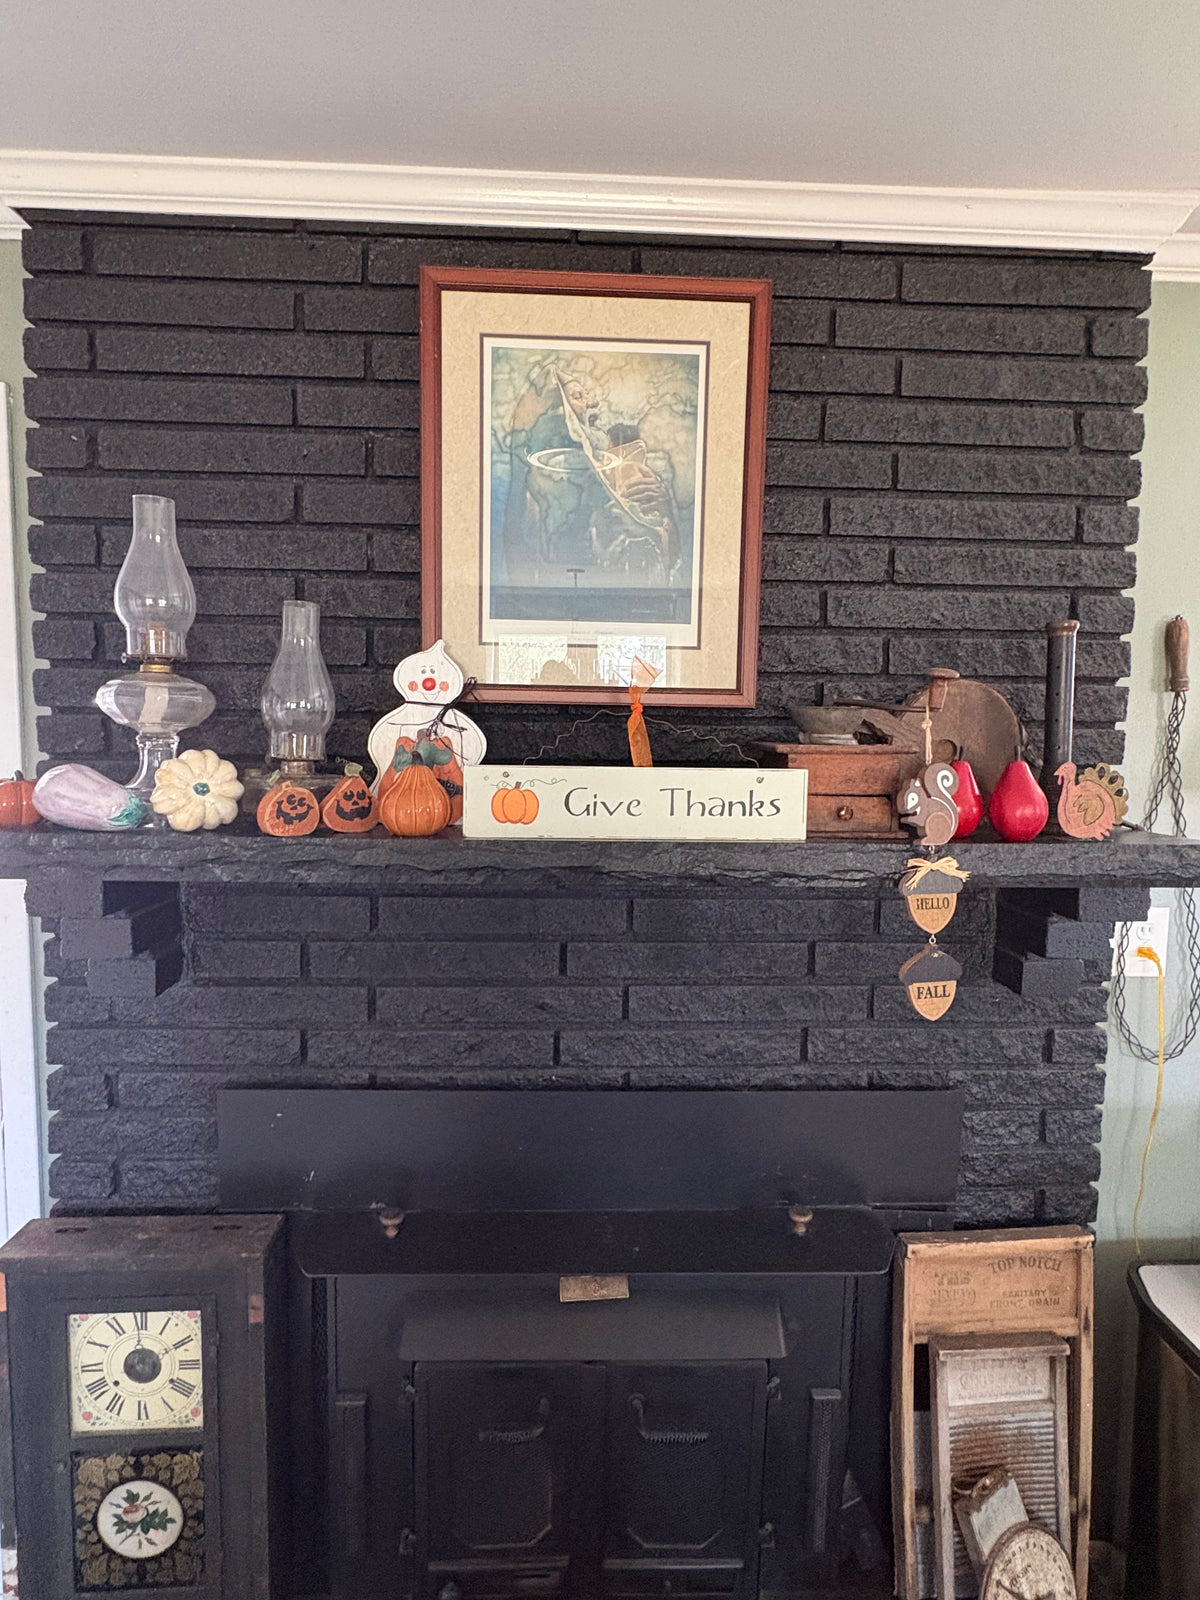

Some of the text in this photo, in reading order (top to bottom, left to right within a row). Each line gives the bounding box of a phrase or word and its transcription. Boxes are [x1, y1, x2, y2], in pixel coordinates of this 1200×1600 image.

[564, 787, 781, 817] Give Thanks
[915, 896, 950, 910] HELLO
[916, 984, 950, 1000] FALL
[988, 1256, 1063, 1274] TOP NOTCH
[1029, 1297, 1061, 1306] DRAIN
